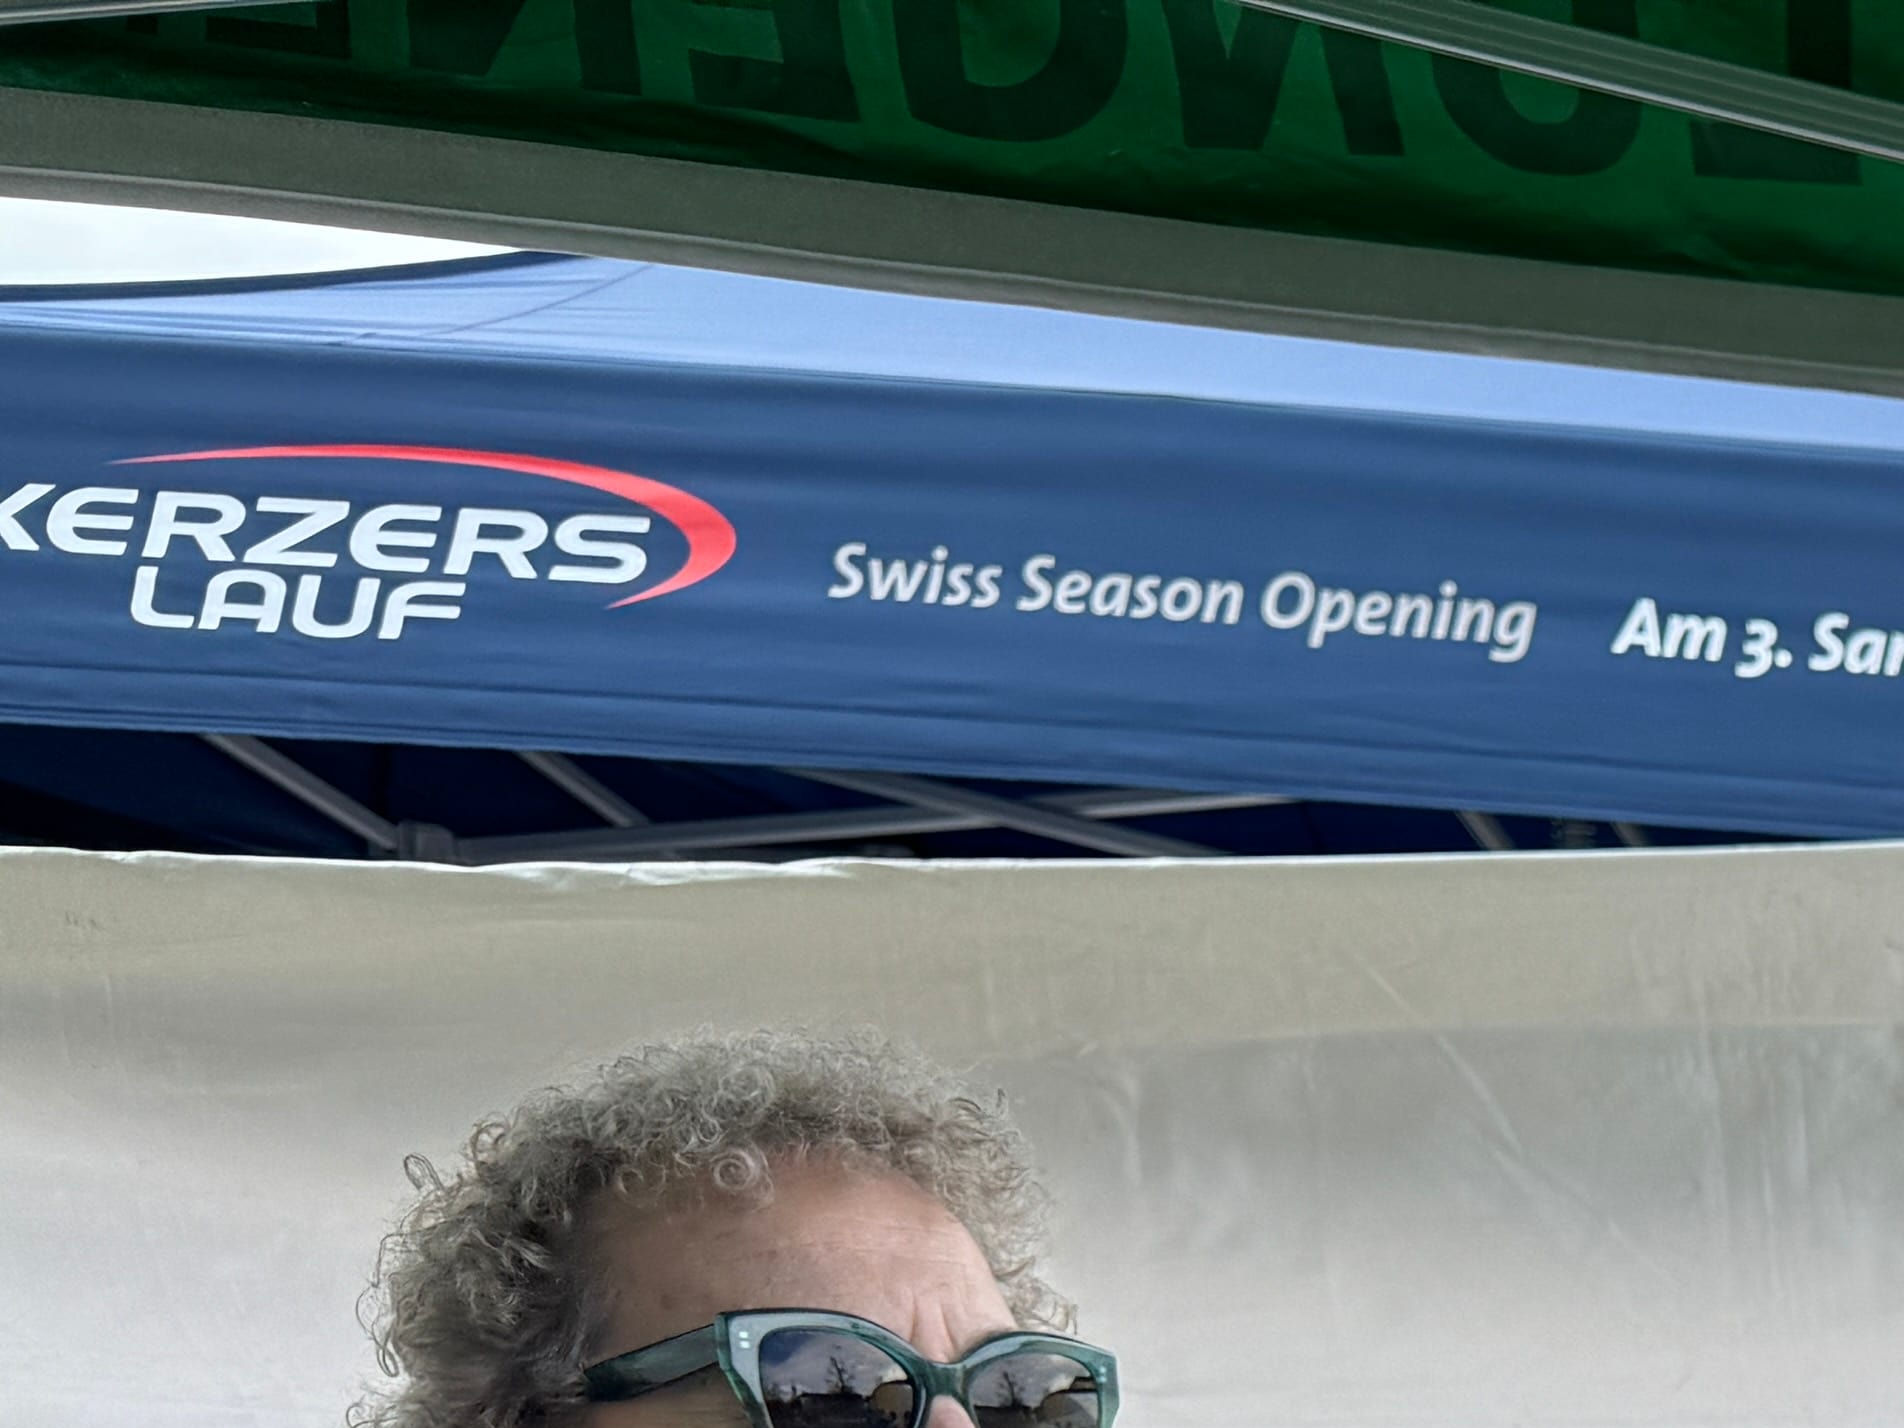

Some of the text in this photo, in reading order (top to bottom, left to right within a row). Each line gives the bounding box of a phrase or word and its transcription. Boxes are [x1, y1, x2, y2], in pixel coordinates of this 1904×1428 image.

[0, 483, 651, 585] KERZERS
[130, 565, 467, 640] LAUF
[829, 543, 1537, 663] Swiss Season Opening
[1612, 598, 1726, 663] Am
[1735, 619, 1792, 678] 3.
